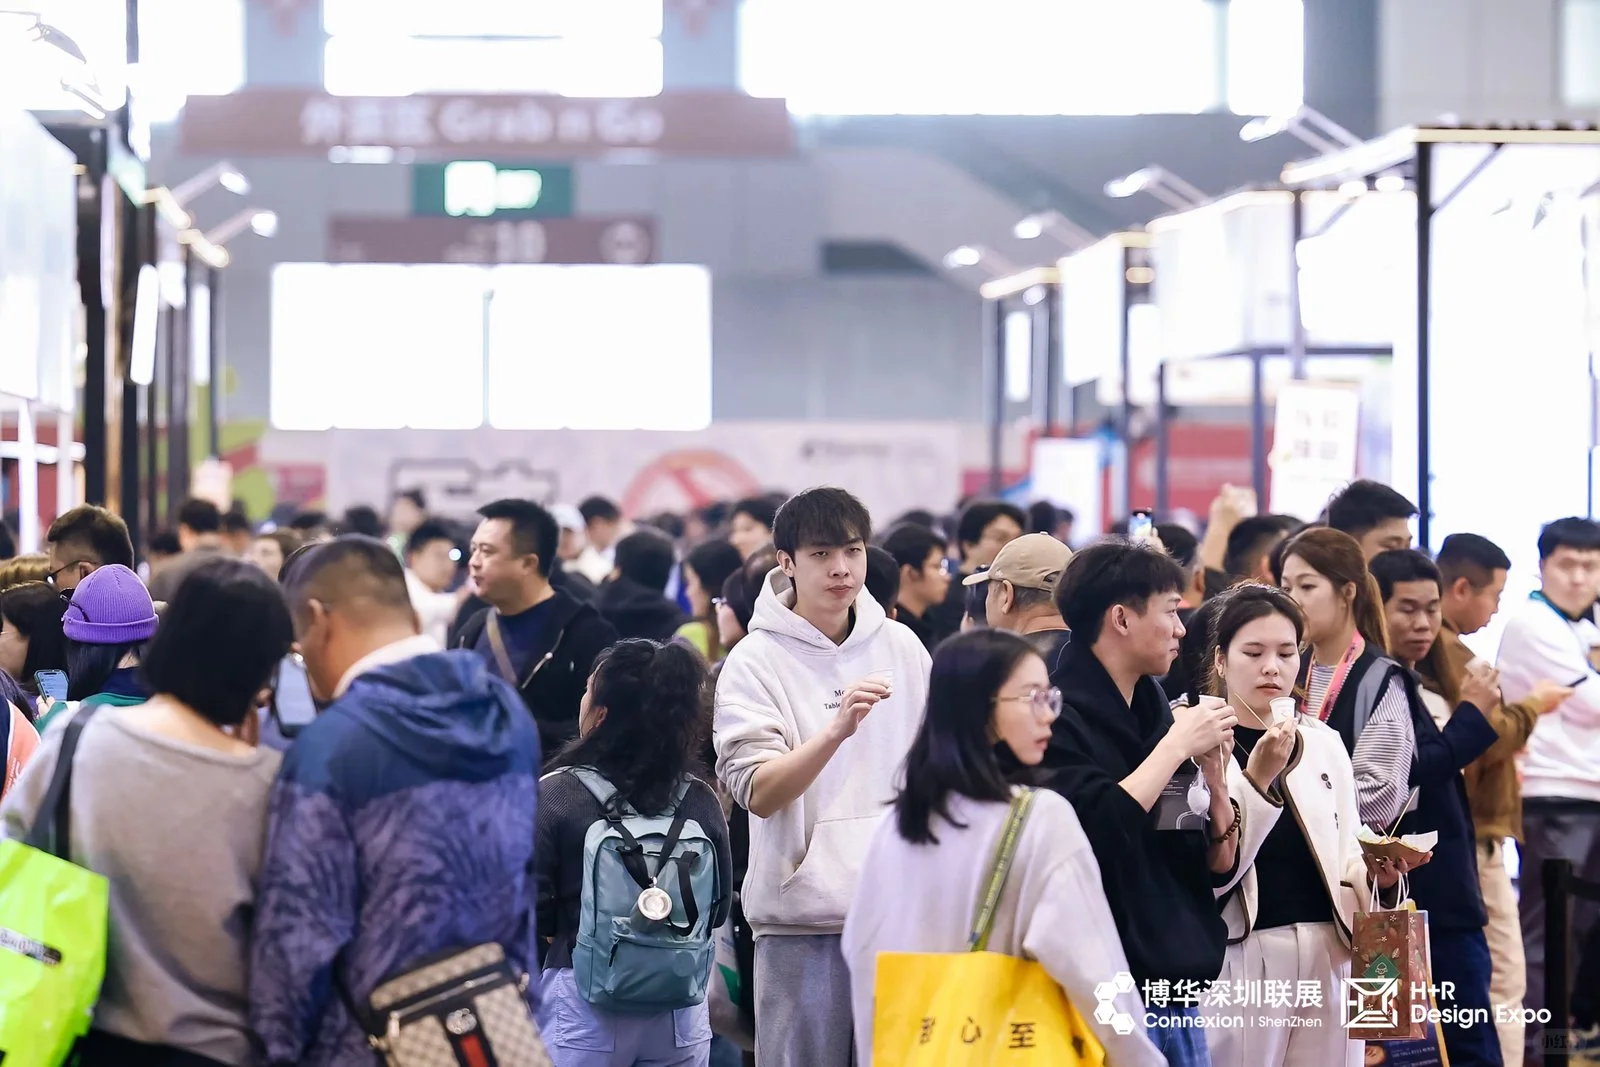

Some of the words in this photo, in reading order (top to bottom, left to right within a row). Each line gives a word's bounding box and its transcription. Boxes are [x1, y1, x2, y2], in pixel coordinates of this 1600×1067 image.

[438, 98, 554, 144] Grab
[556, 108, 591, 143] n
[595, 98, 665, 144] Go
